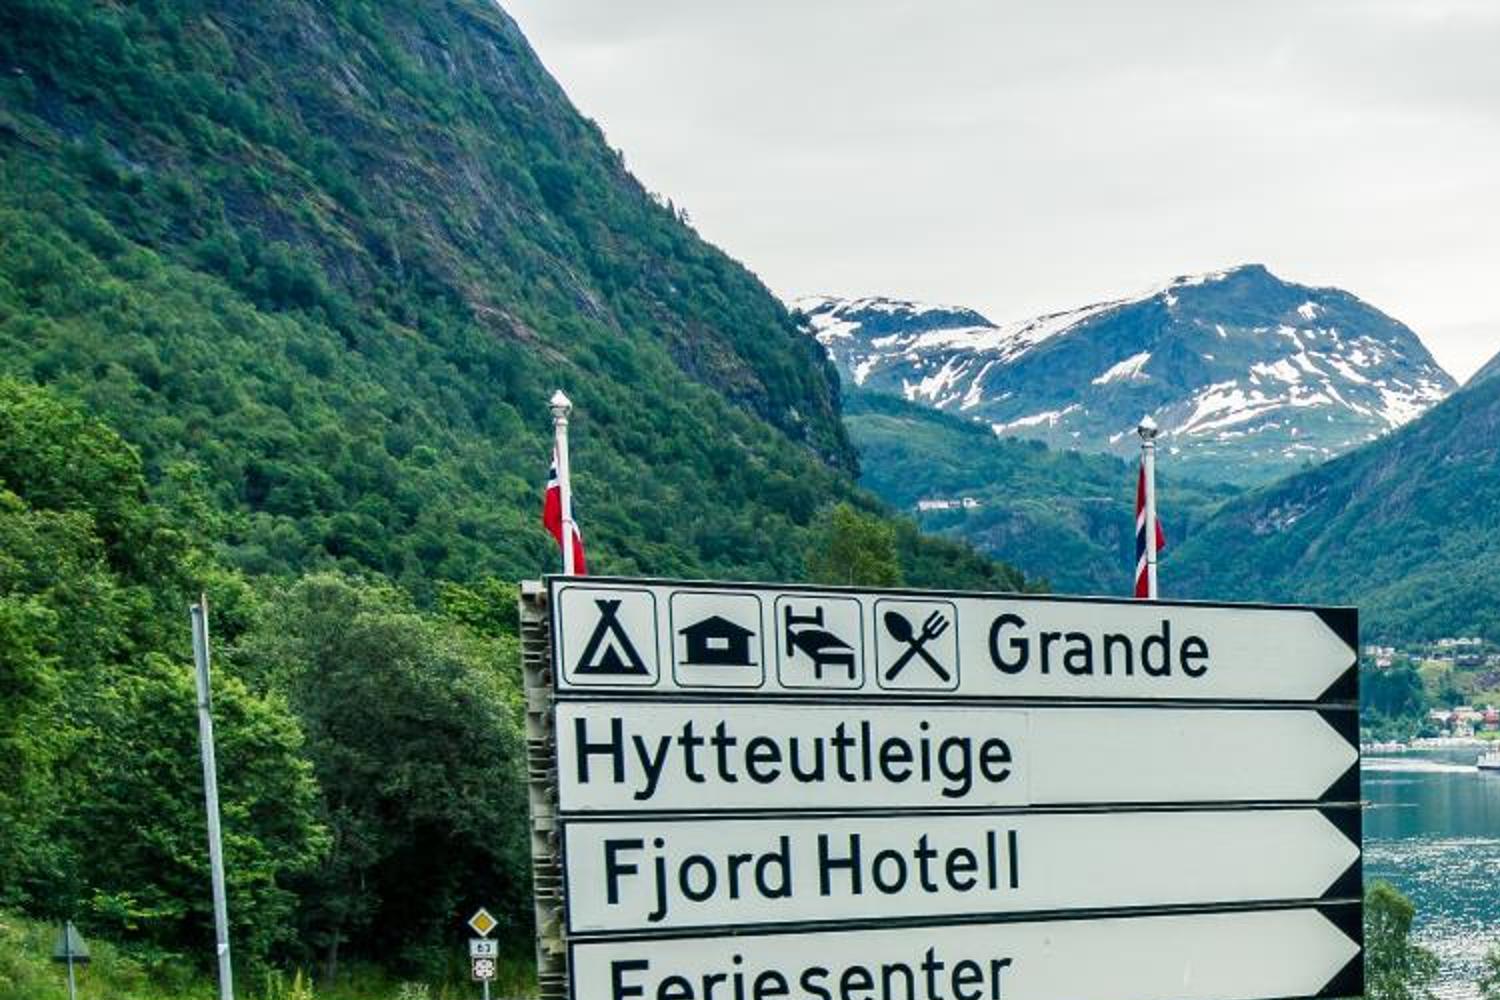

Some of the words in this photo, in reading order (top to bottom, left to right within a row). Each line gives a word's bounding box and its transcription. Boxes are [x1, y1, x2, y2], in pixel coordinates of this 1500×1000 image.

[987, 612, 1211, 679] Grande
[573, 716, 1013, 801] Hytteutleige
[603, 835, 793, 923] Fjord
[816, 828, 1020, 897] Hotell
